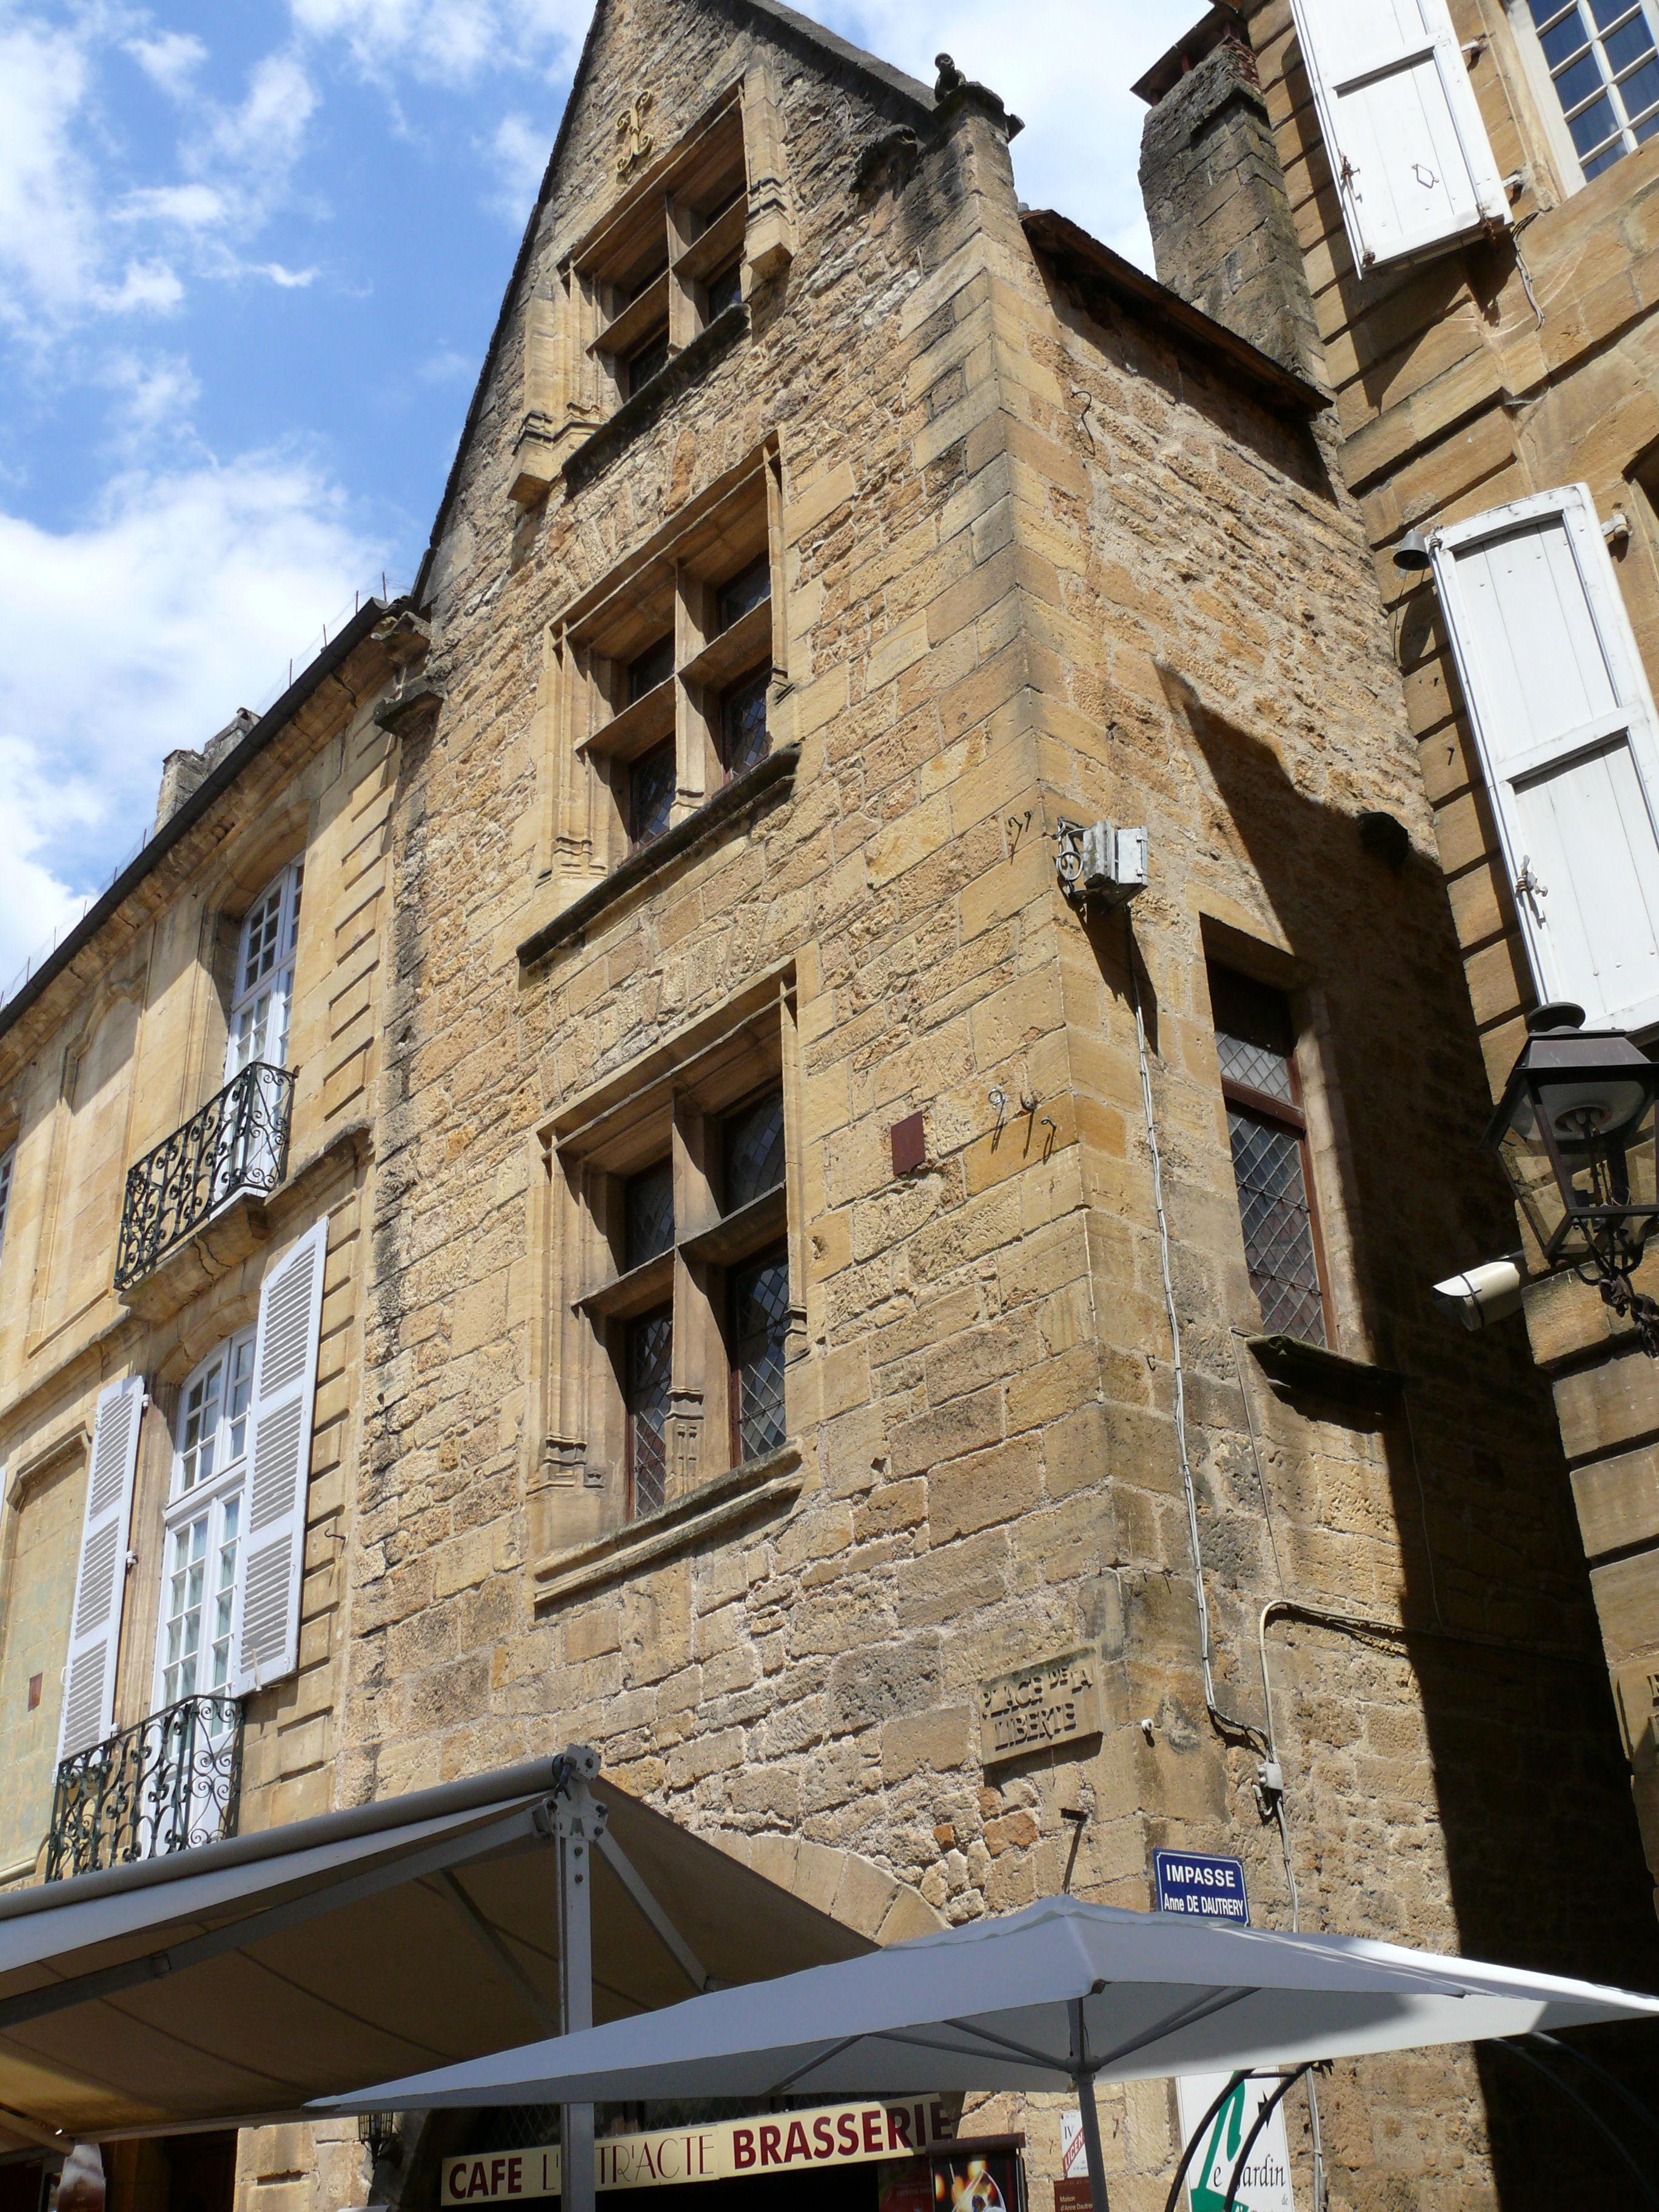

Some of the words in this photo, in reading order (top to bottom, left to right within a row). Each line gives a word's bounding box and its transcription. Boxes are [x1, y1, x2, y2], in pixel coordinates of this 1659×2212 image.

[981, 1676, 1043, 1720] PLACE
[1166, 1864, 1236, 1888] IMPASSE
[1164, 1892, 1185, 1911] Anne
[1186, 1895, 1200, 1912] DE
[1201, 1896, 1244, 1916] DAUTRERY
[449, 2157, 522, 2199] CAFE
[732, 2100, 953, 2171] BRASSERIE
[1237, 2154, 1285, 2192] ardin
